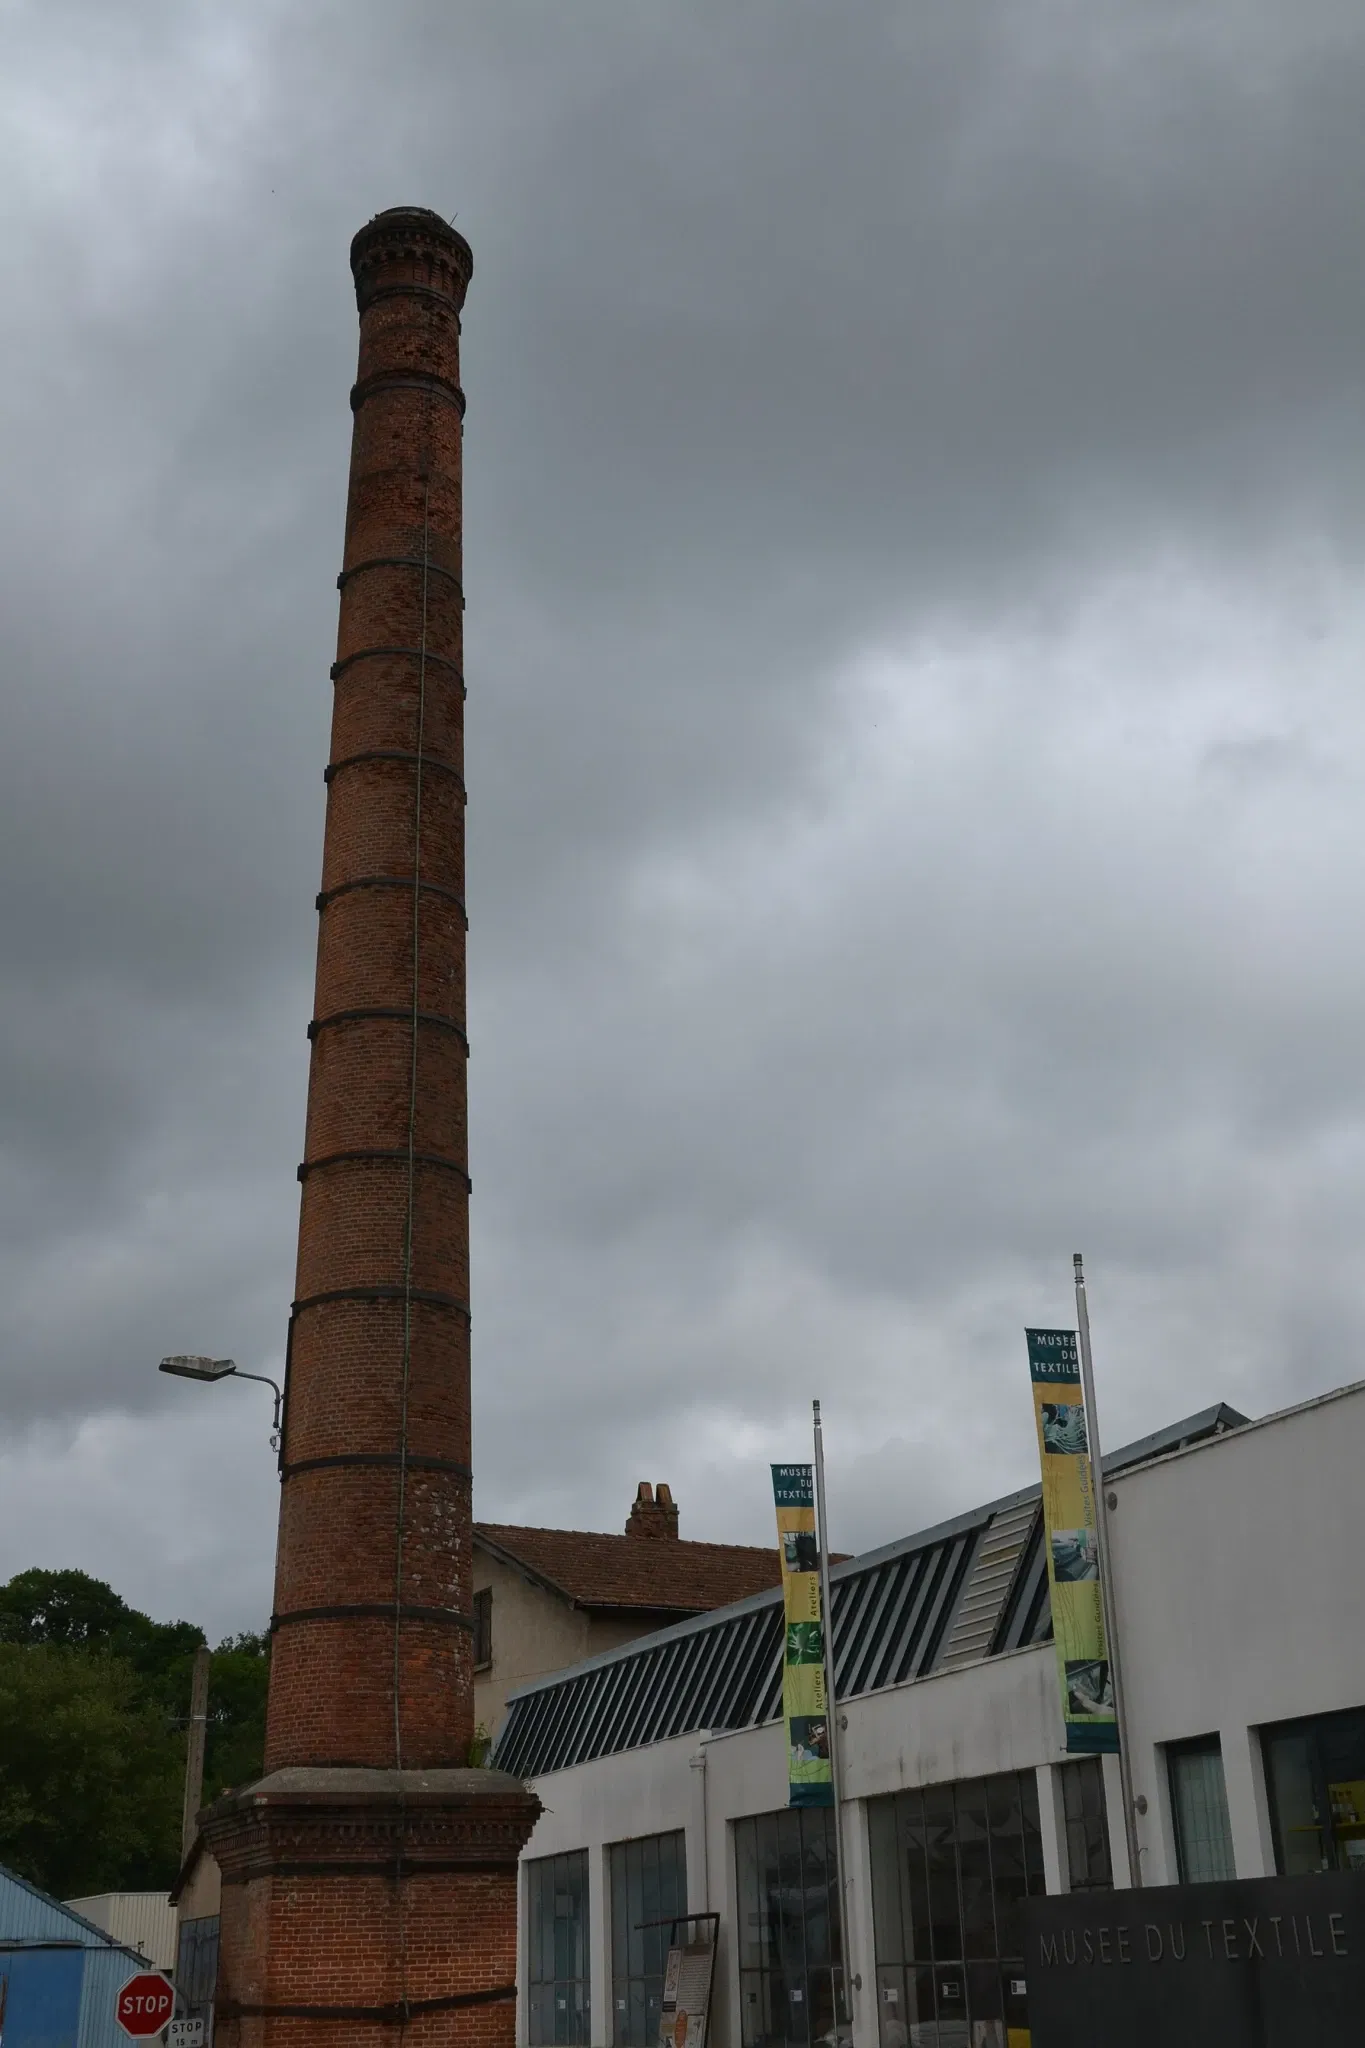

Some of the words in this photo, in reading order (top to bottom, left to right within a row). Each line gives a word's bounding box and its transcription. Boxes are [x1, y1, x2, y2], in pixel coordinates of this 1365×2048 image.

[1061, 1350, 1077, 1360] DU
[1034, 1362, 1079, 1373] TEXTILE
[1080, 1455, 1089, 1493] Guidées
[800, 1479, 812, 1488] DU
[777, 1490, 813, 1499] TEXTILE
[1084, 1495, 1092, 1527] Visites
[809, 1576, 817, 1616] Ateliers
[814, 1670, 823, 1709] Ateliers
[1040, 1925, 1133, 1968] MUSEE
[1144, 1921, 1187, 1963] DU
[1201, 1912, 1349, 1960] TEXTILE
[122, 1995, 169, 2014] STOP
[172, 2021, 202, 2033] STOP
[176, 2038, 185, 2046] 15
